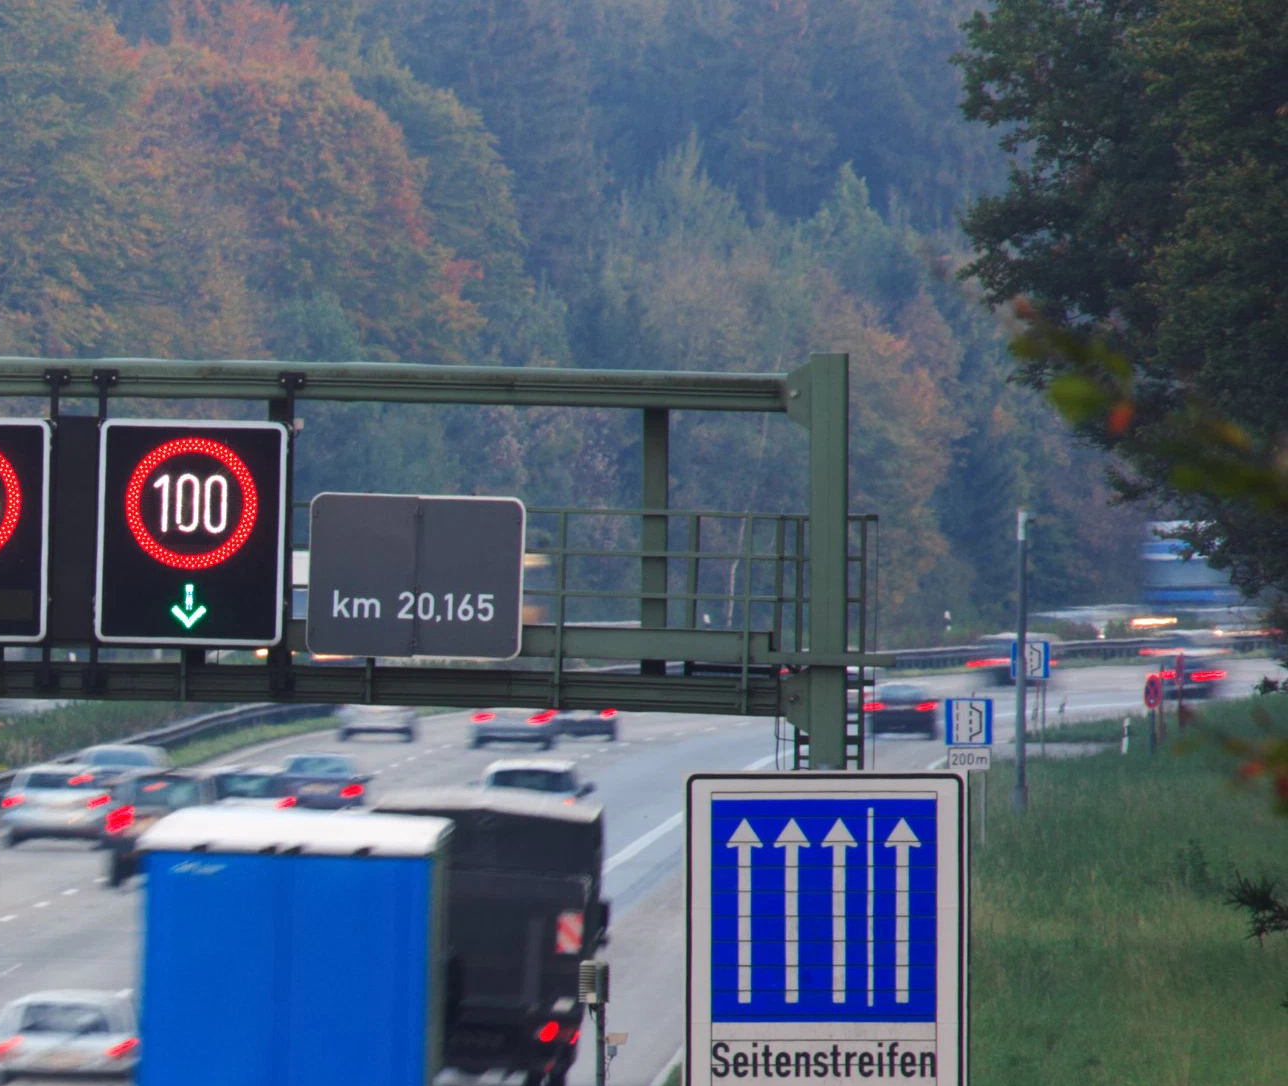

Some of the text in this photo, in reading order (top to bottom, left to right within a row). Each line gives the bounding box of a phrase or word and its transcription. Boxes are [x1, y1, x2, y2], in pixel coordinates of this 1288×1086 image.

[153, 473, 229, 534] 100
[332, 590, 495, 623] km 20,165
[711, 1042, 936, 1078] Seitenstreifen
